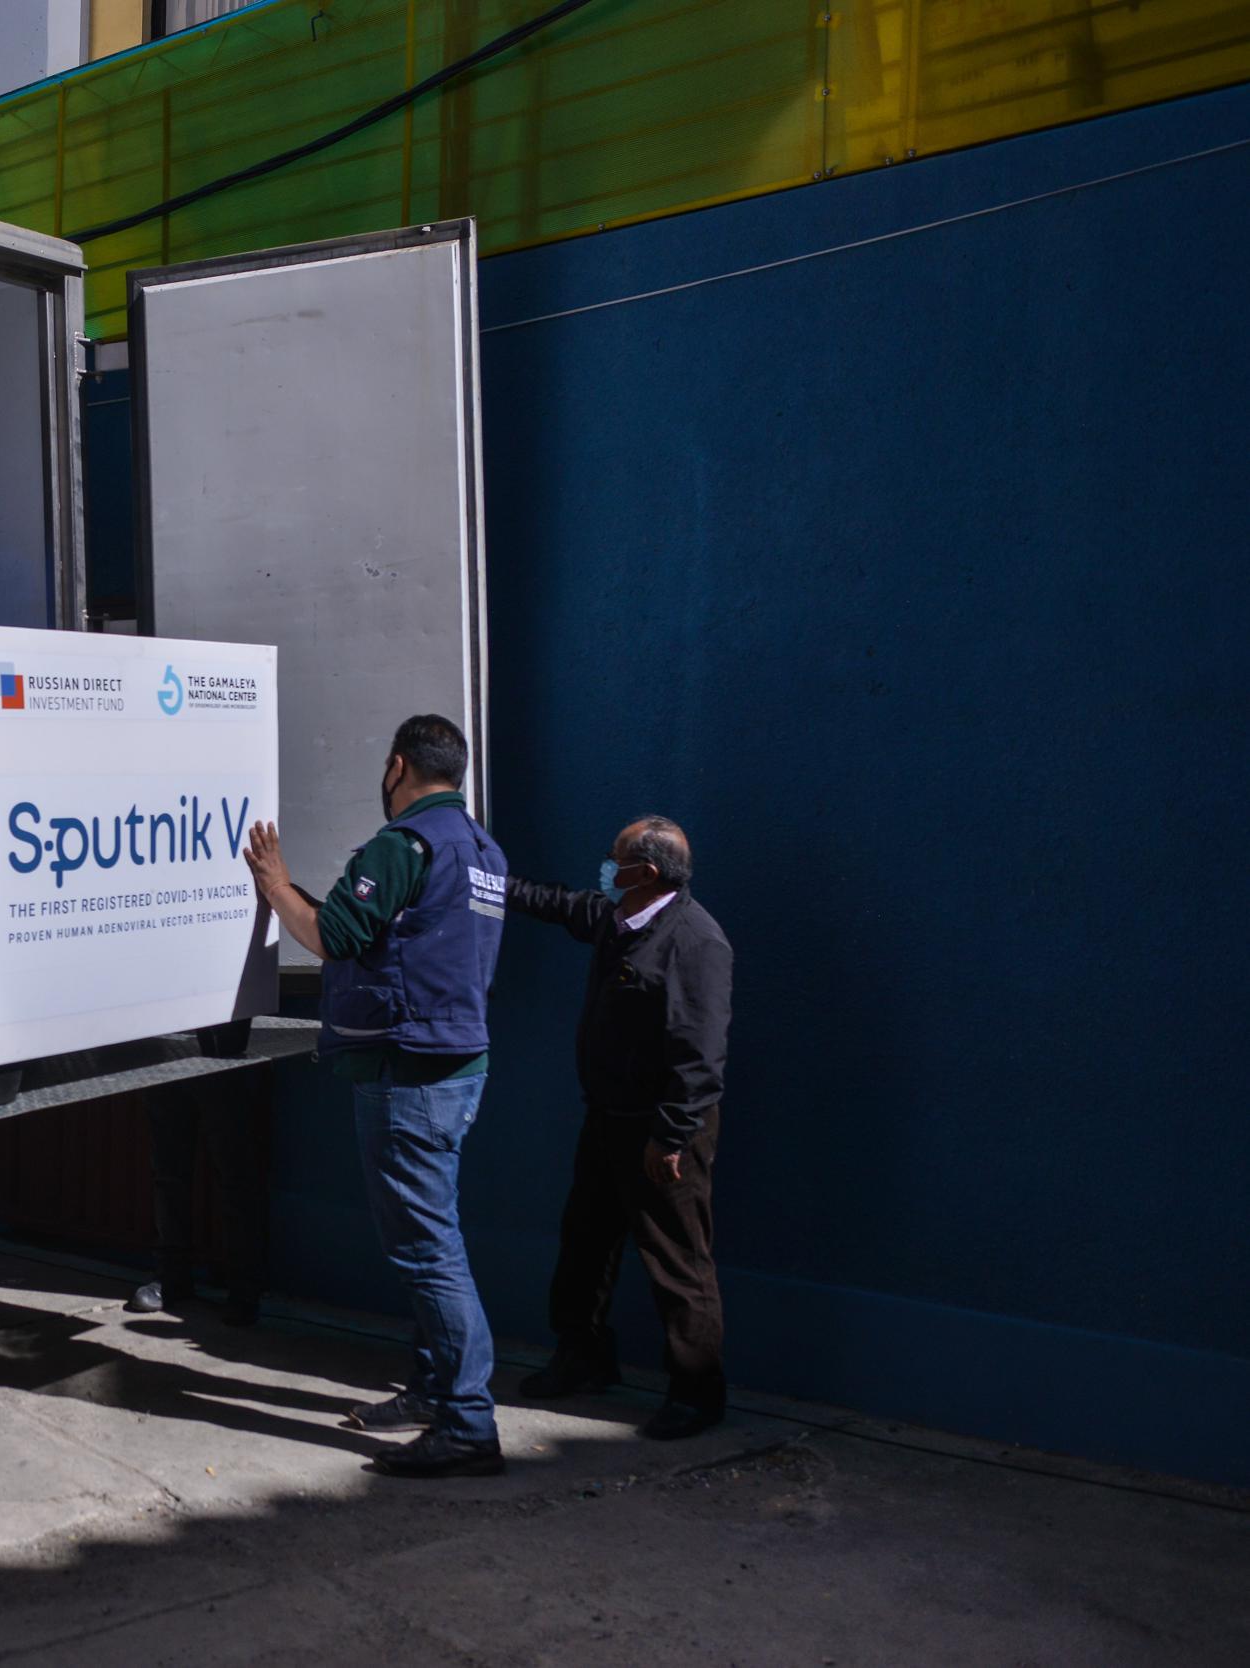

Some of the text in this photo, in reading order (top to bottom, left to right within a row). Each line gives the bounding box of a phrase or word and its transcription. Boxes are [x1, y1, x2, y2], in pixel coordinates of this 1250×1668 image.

[28, 676, 122, 692] RUSSIAN DIRECT
[188, 675, 257, 689] THE GAMALEYA
[29, 696, 125, 712] INVESTMENT FUND
[188, 690, 257, 702] NATIONAL CENTER
[9, 795, 249, 889] Sputnik V
[9, 884, 249, 918] THE FIRST REGISTERED COVID-19 VACCINE
[8, 908, 249, 944] PROVEN HUMAN ADENOVIRAL VECTOR TECHNOLOGY
